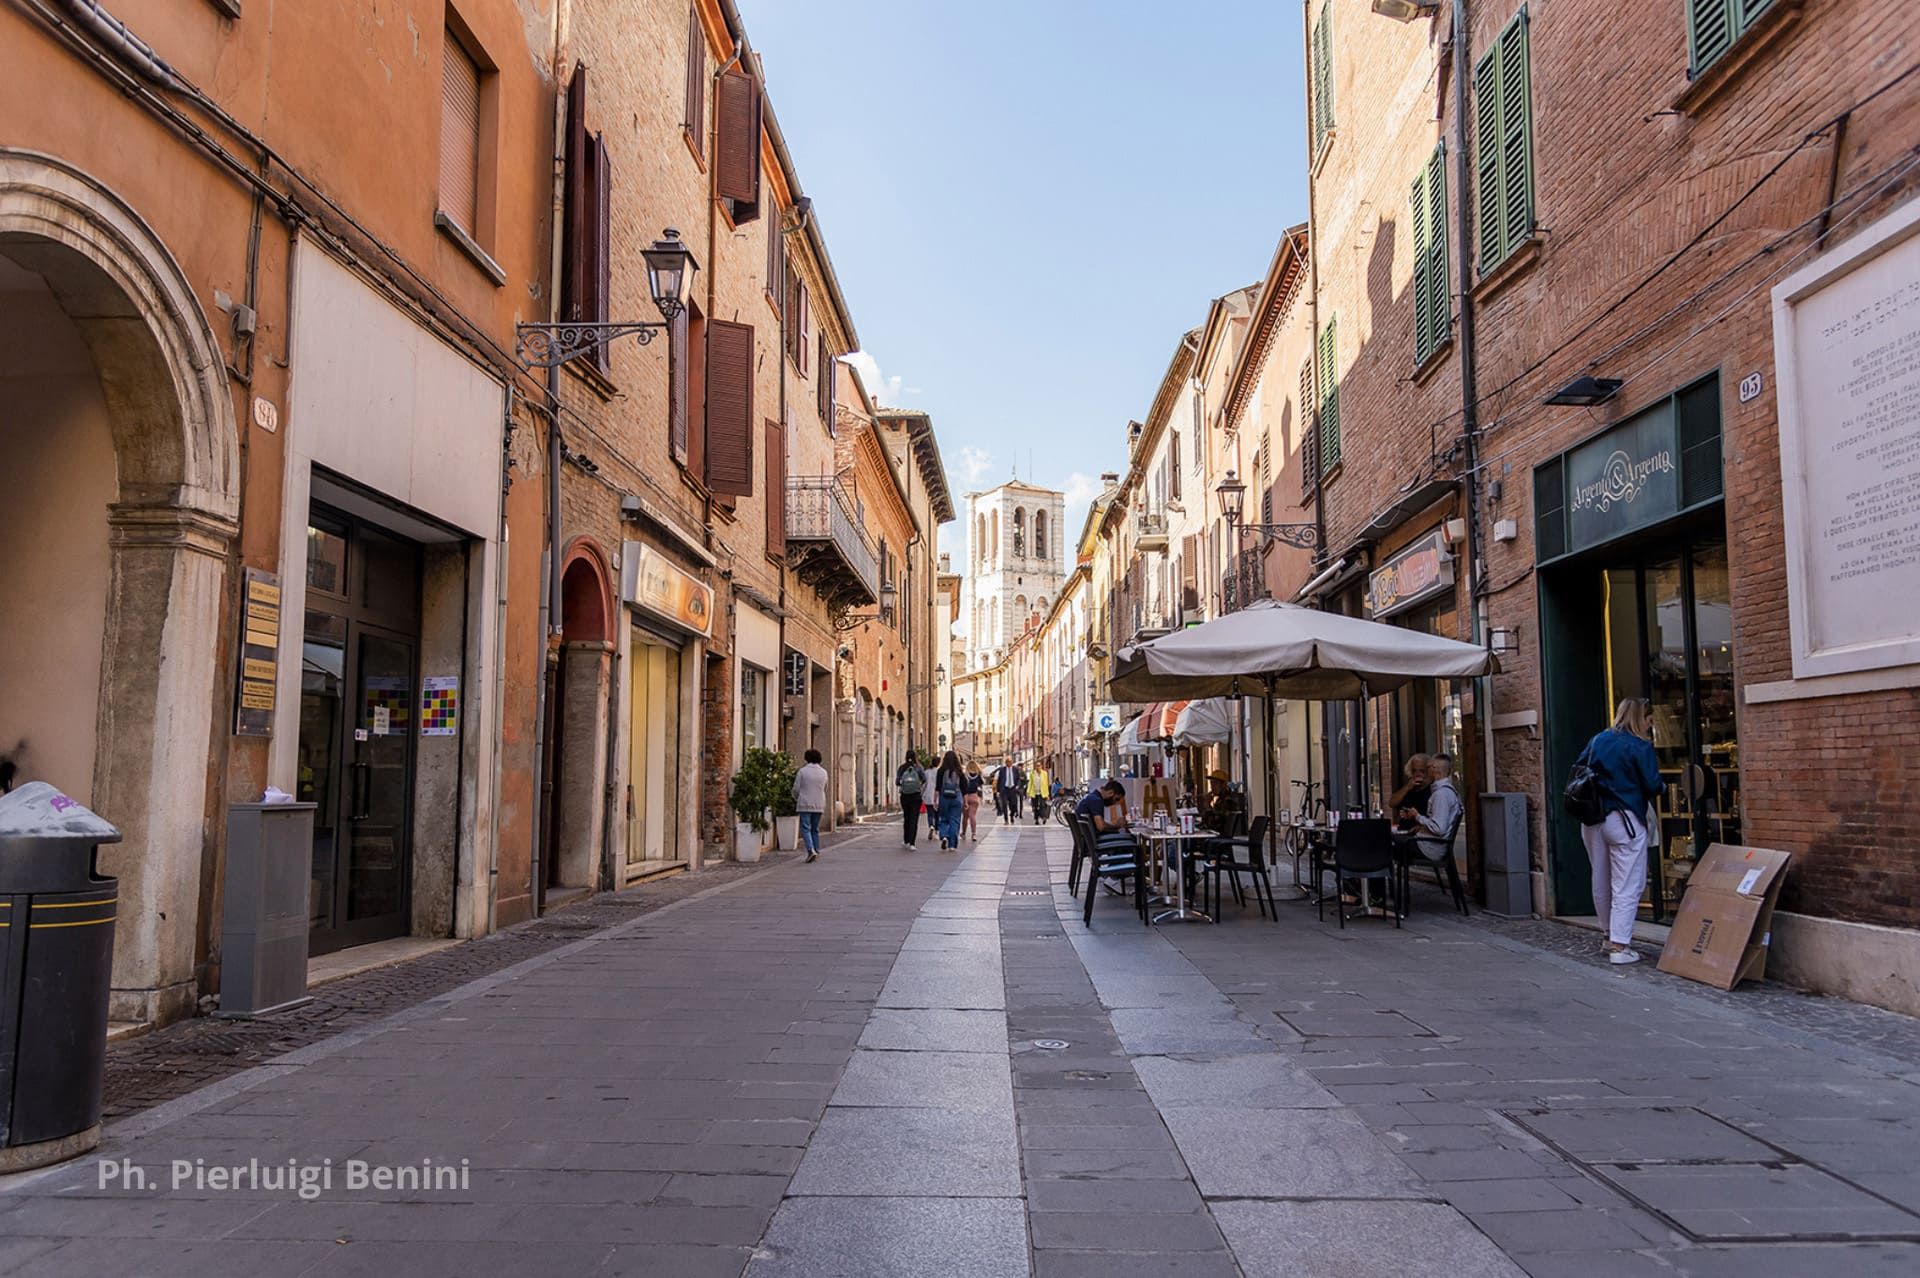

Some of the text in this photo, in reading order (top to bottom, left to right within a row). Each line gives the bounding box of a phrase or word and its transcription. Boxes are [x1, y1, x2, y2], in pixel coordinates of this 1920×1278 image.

[1866, 341, 1895, 361] POPOLO
[1571, 478, 1611, 512] Argento
[1628, 451, 1675, 486] Argento
